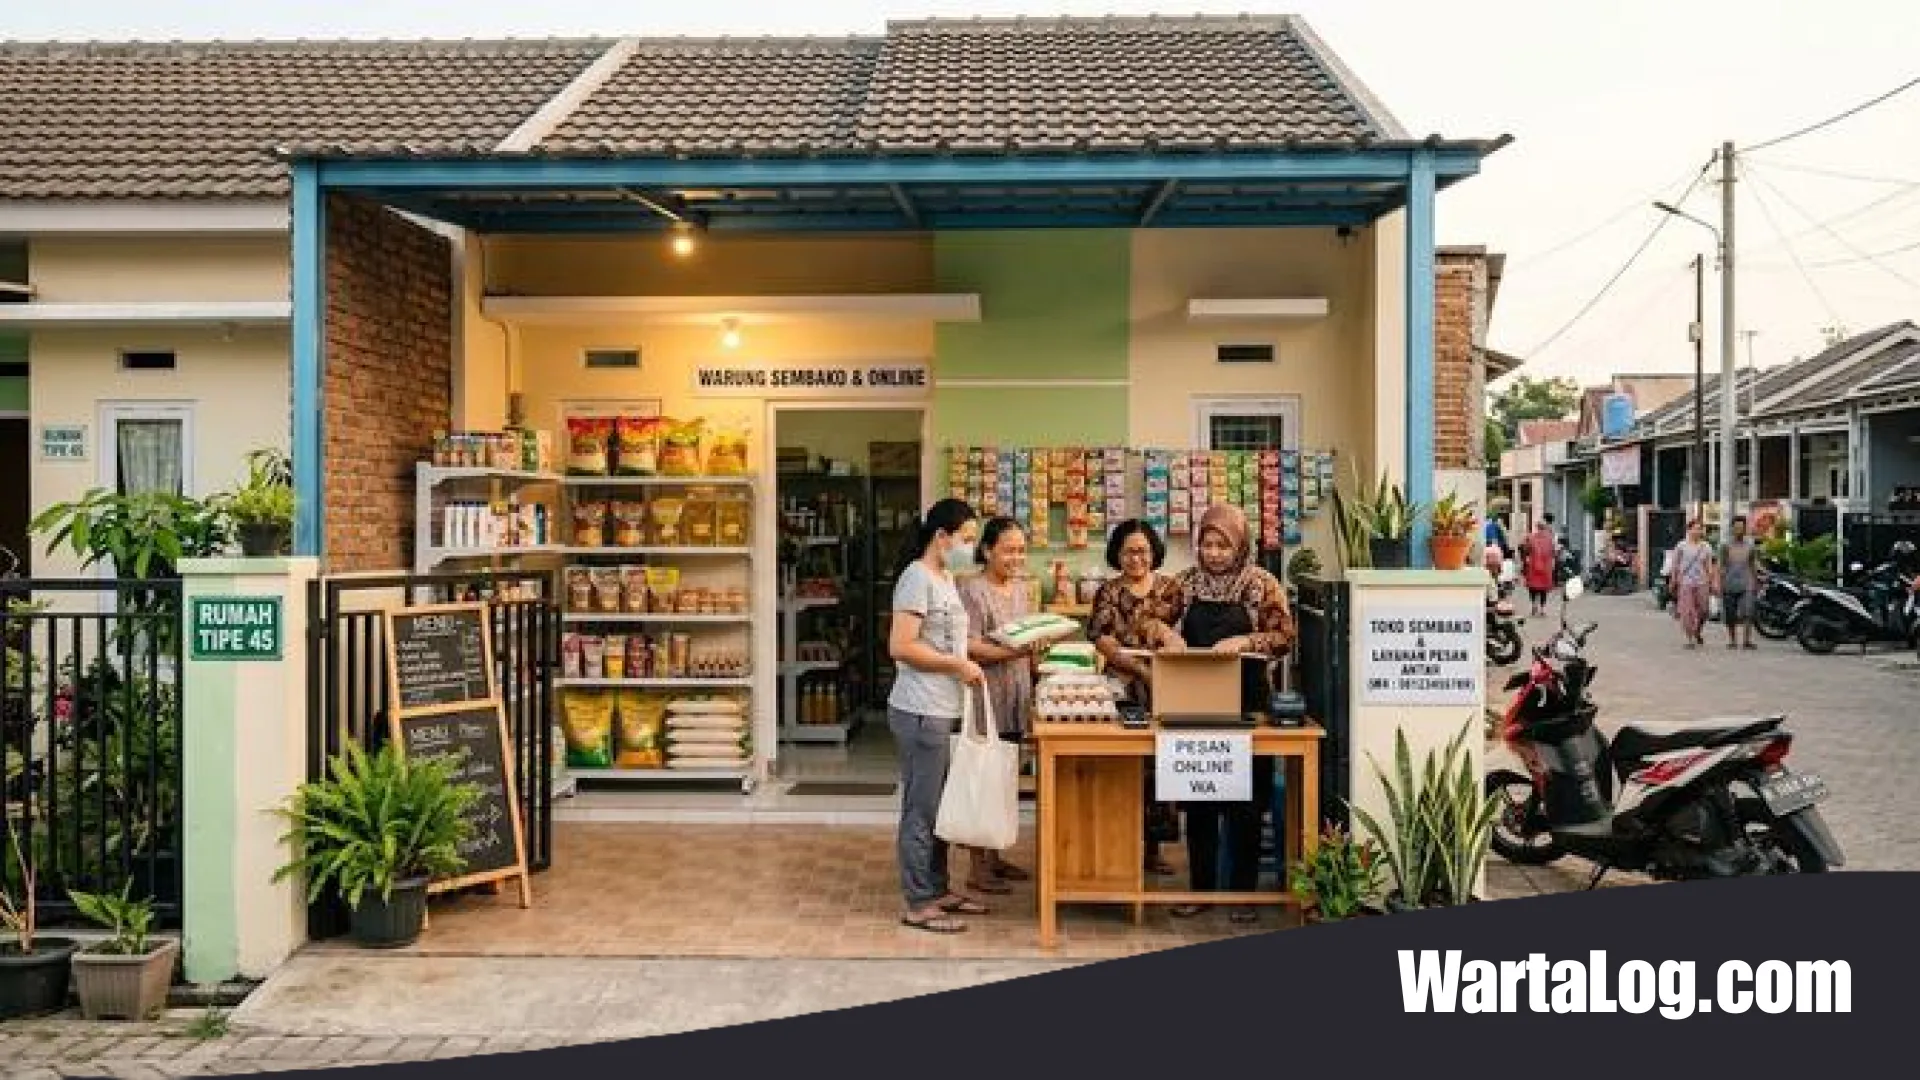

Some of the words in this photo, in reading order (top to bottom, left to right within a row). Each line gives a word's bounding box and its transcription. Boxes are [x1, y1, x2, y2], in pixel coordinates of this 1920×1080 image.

[699, 369, 765, 386] WARUNG
[769, 369, 847, 386] SEMBAKO
[850, 369, 863, 386] &
[867, 369, 925, 386] ONLINE
[199, 603, 273, 625] RUMAH
[1369, 619, 1404, 633] TOKO
[1408, 619, 1473, 633] SEMBAKO
[199, 629, 243, 651] TIPE
[247, 629, 274, 651] 45
[1429, 649, 1468, 661] PESAN
[1175, 740, 1230, 754] PESAN
[1173, 760, 1233, 773] ONLINE
[1189, 780, 1217, 794] WA
